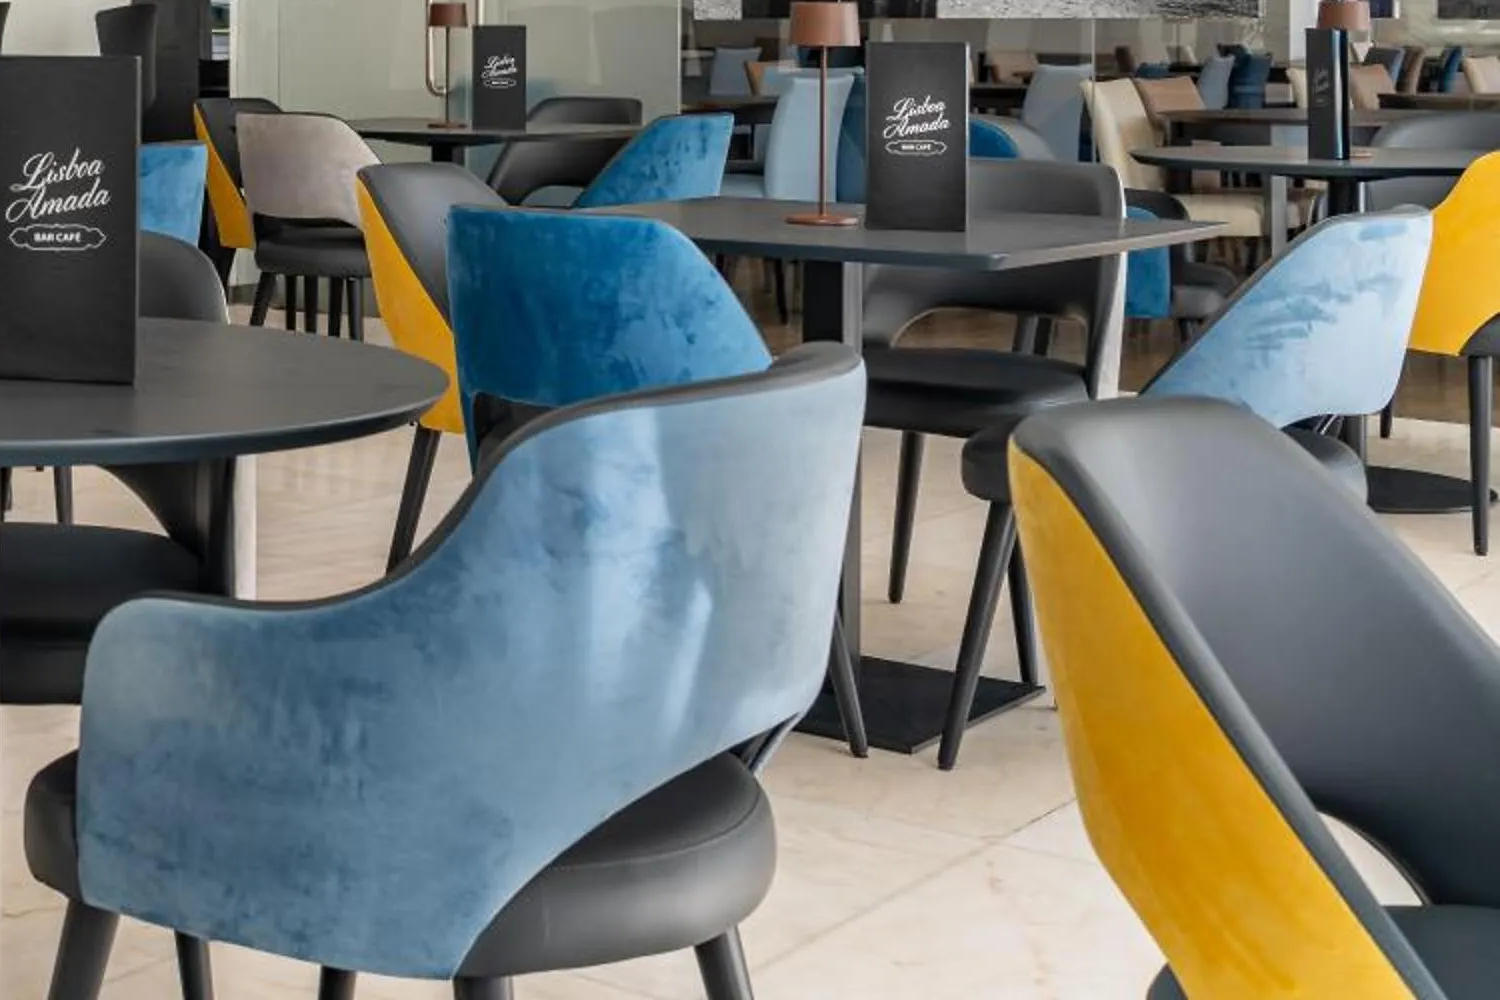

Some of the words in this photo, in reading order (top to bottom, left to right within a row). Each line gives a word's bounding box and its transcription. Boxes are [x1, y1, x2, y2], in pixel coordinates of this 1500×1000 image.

[885, 95, 947, 121] Lisboa
[883, 112, 950, 139] Amada
[9, 147, 105, 191] Lisboa
[4, 177, 111, 223] Amada
[33, 231, 55, 243] BAR
